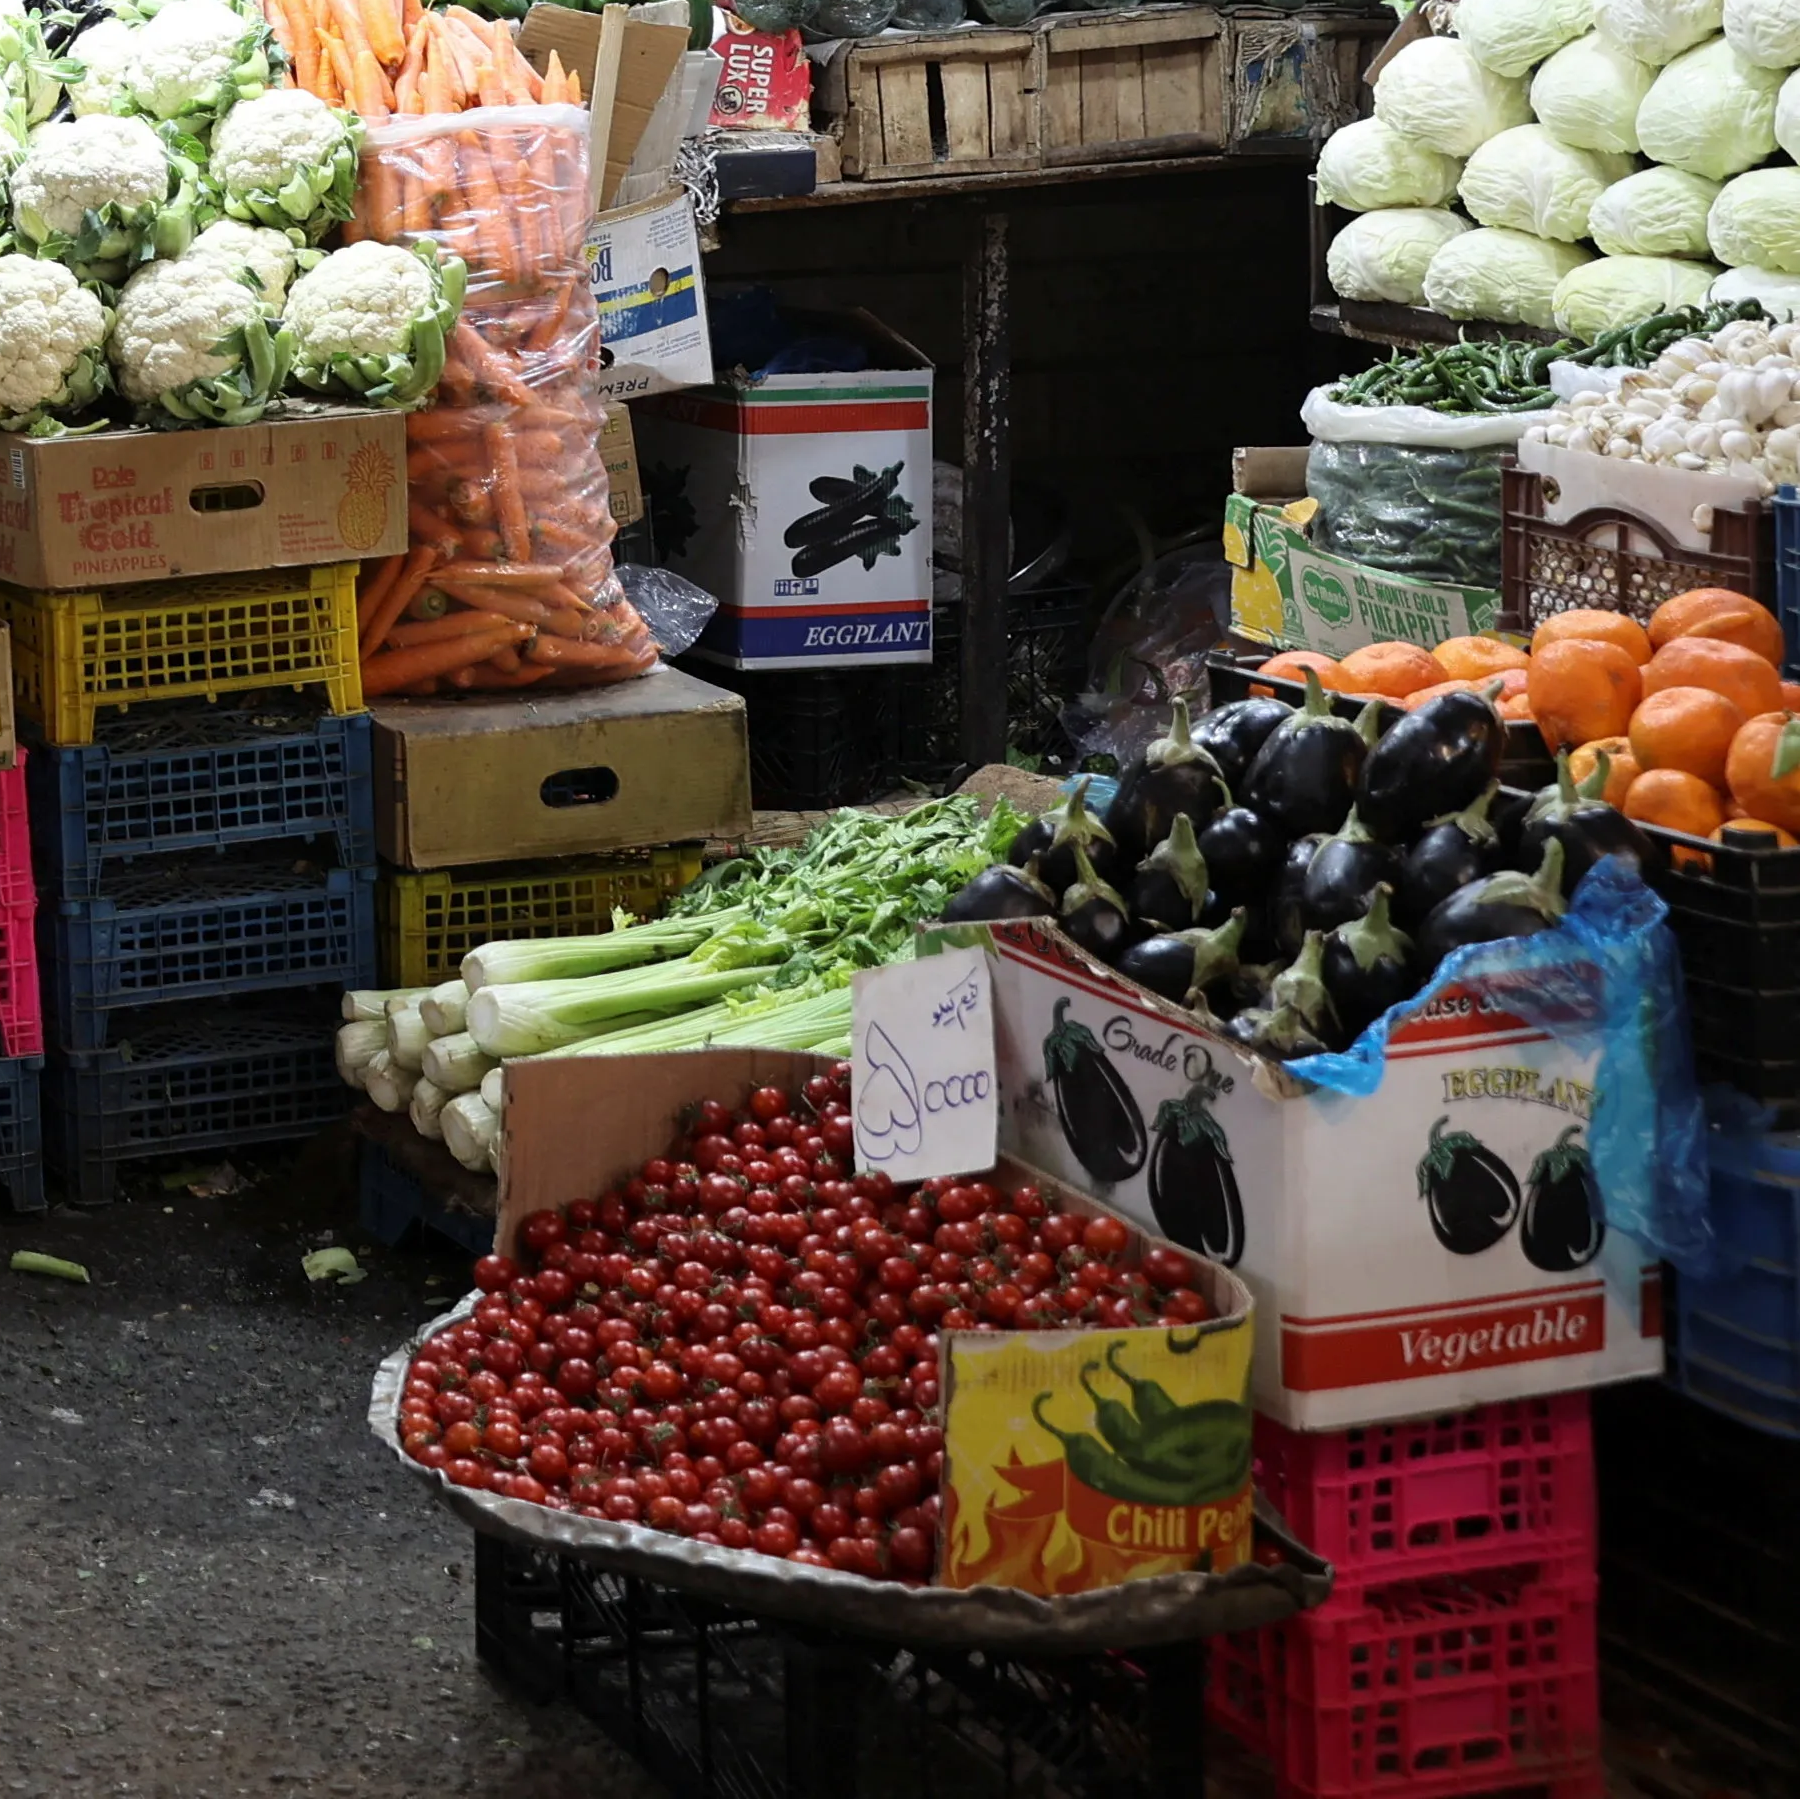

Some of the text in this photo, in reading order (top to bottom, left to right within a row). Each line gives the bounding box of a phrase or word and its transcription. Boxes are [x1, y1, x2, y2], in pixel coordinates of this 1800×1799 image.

[726, 43, 753, 83] LUX
[745, 43, 775, 114] SUPER
[598, 376, 649, 397] PREM
[92, 464, 137, 490] Dole
[57, 486, 174, 525] Tropical
[78, 520, 160, 553] Gold
[72, 553, 168, 576] PINEAPPLES
[1375, 583, 1411, 609] MONTE
[1414, 587, 1449, 617] GOLD
[804, 621, 930, 647] EGGPLANT
[1357, 598, 1451, 646] PINEAPPLE
[1102, 1014, 1236, 1096] Grade One
[1399, 1307, 1588, 1369] Vegetable
[1105, 1504, 1186, 1549] Chili
